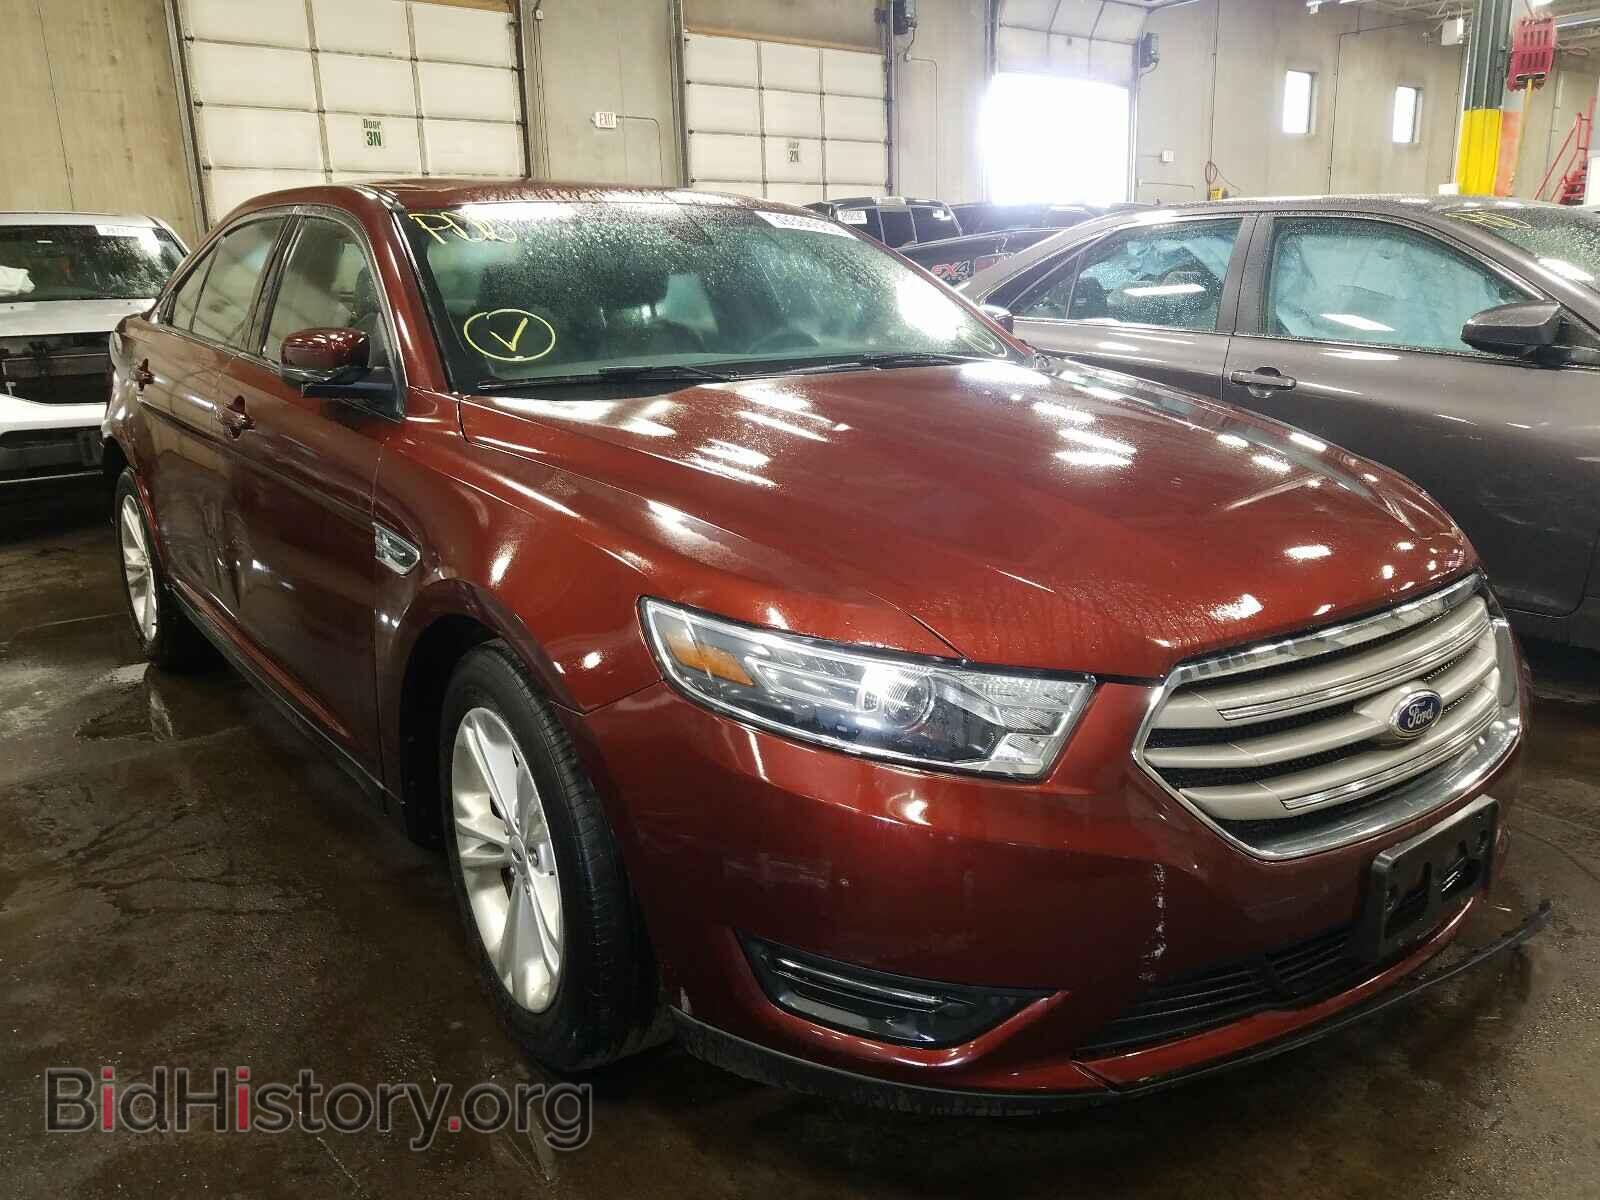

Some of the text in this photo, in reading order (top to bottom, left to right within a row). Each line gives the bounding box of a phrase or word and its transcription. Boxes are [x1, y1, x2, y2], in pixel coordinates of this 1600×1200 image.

[363, 118, 381, 129] Door
[600, 112, 613, 126] EXIT
[366, 131, 381, 146] 3N
[1408, 701, 1433, 728] Ford
